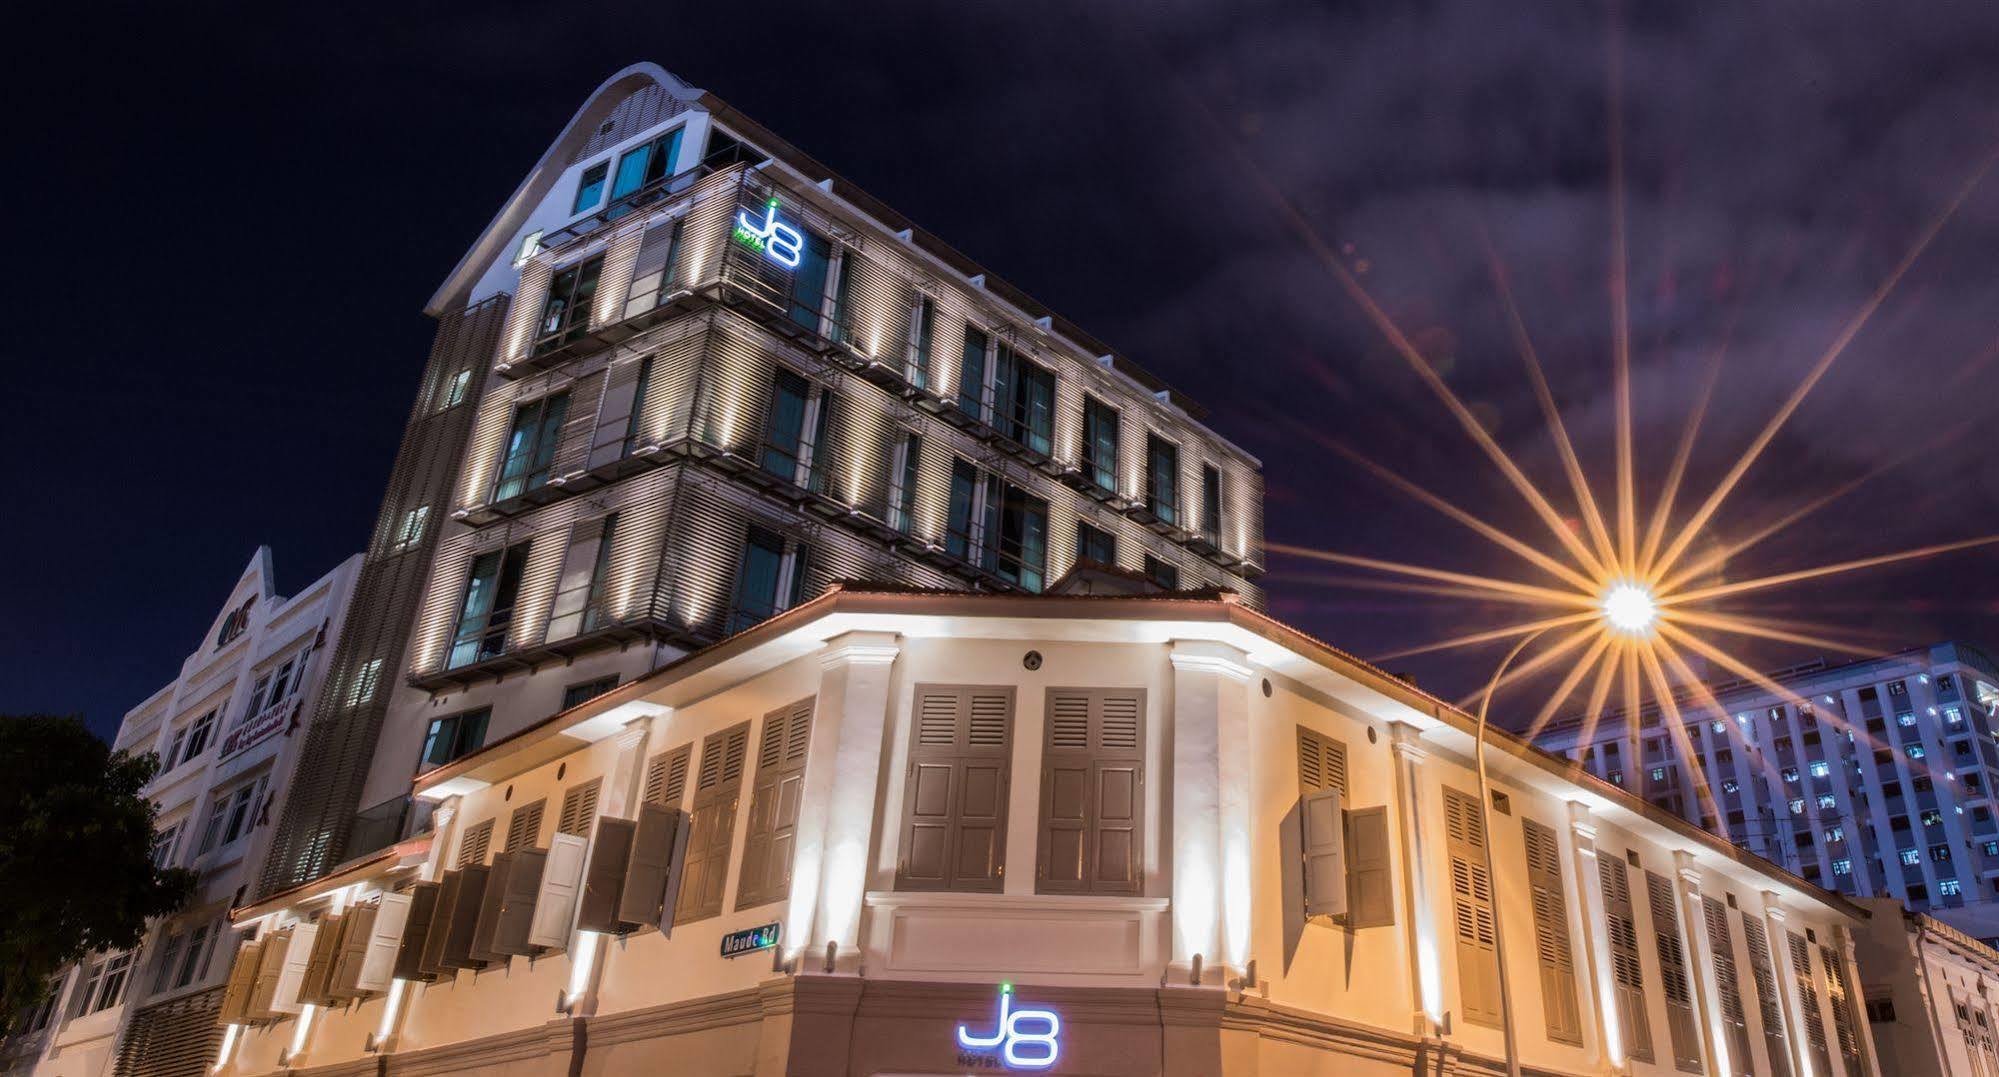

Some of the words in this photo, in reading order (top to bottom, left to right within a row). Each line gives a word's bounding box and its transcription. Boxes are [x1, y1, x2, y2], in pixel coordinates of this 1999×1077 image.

[738, 226, 766, 249] HOTEL
[724, 931, 759, 953] Maude
[762, 926, 776, 945] Rd
